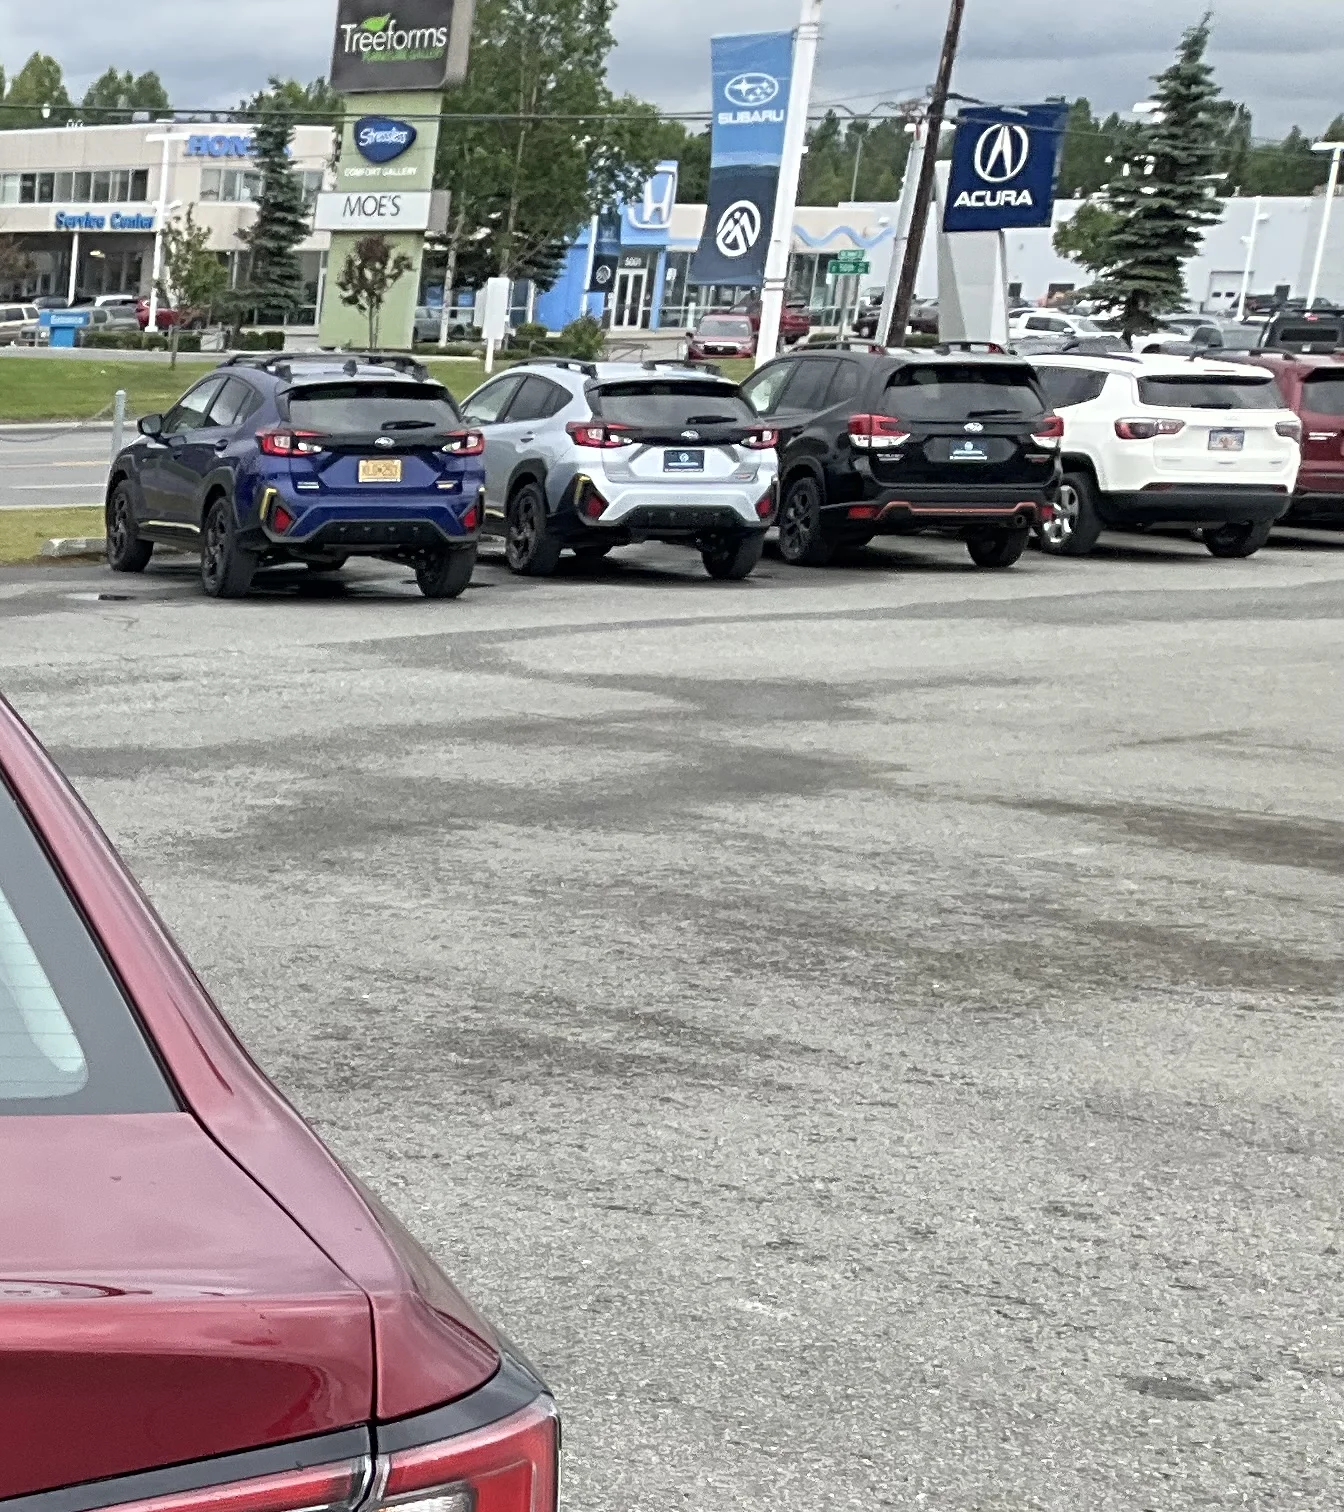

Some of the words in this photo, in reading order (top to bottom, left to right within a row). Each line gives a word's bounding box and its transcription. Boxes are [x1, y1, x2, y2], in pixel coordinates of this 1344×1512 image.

[340, 19, 448, 52] Treeforms
[717, 109, 784, 125] SUBARU
[342, 195, 401, 217] MOE'S
[952, 189, 1033, 208] ACURA
